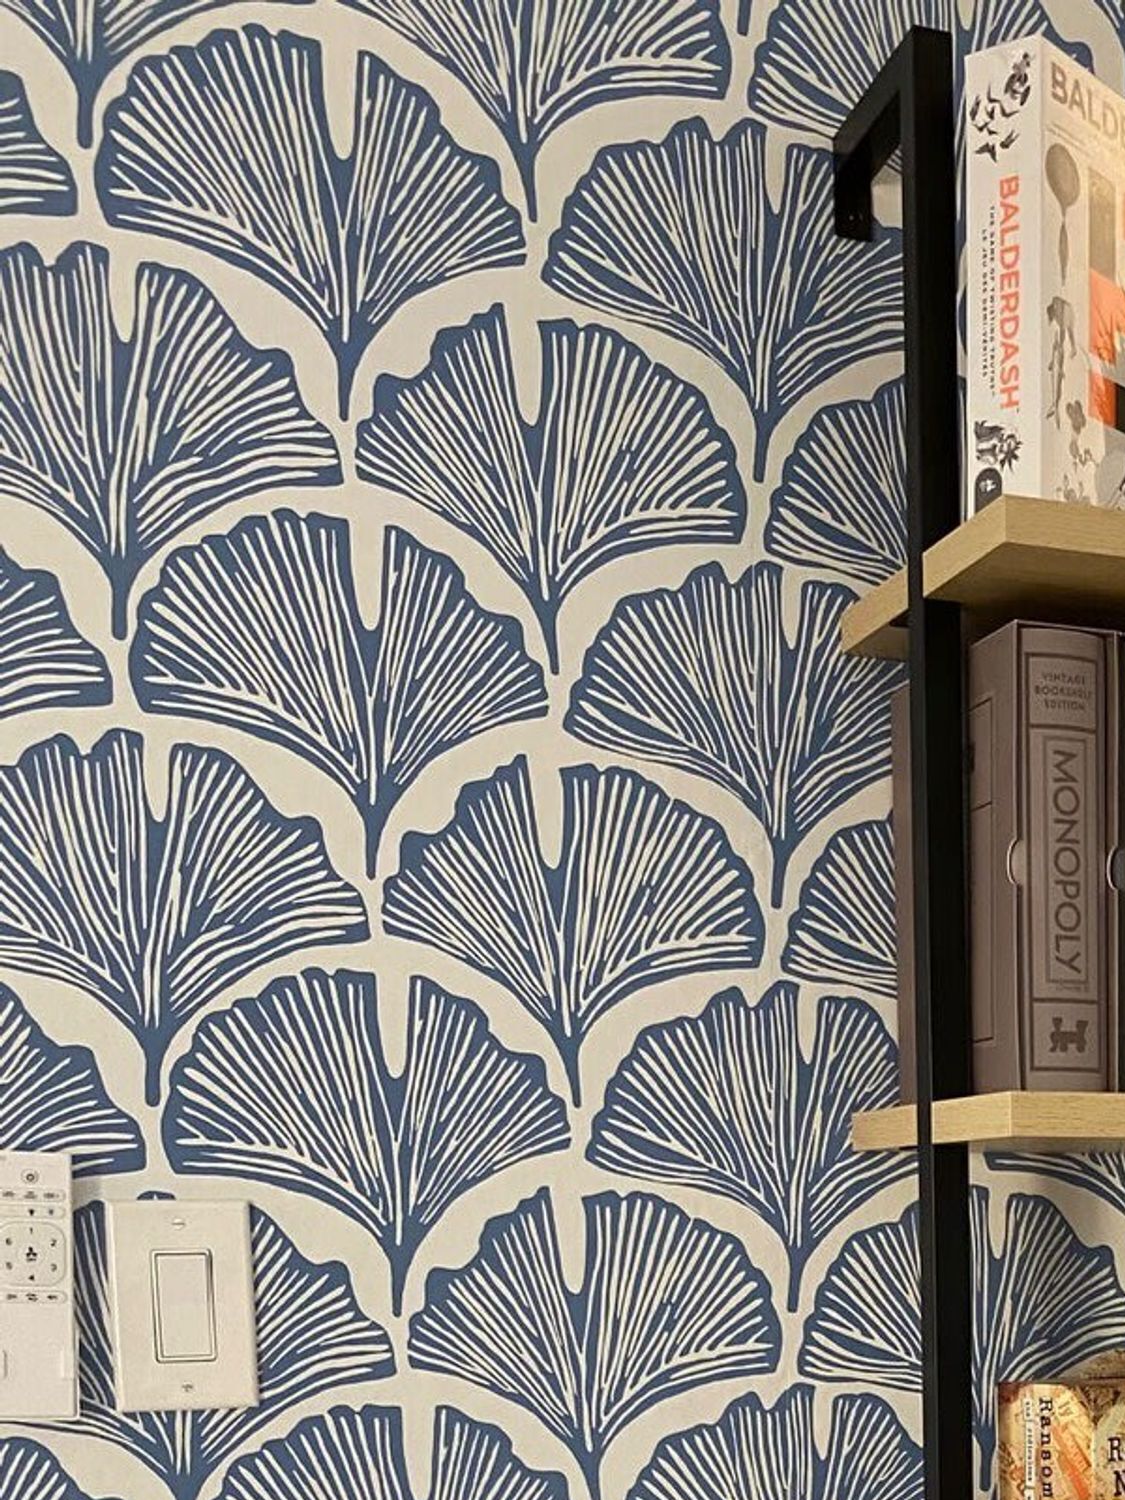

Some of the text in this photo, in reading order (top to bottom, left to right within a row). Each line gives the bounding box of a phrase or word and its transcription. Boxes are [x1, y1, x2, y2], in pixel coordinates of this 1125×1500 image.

[999, 175, 1020, 410] BALDERDASH
[1034, 684, 1093, 698] BOOKSHELF
[1041, 672, 1086, 685] VINTAGE
[1044, 699, 1085, 711] EDITION
[1052, 749, 1082, 974] MONOPOLY
[1039, 1398, 1053, 1499] Ransom
